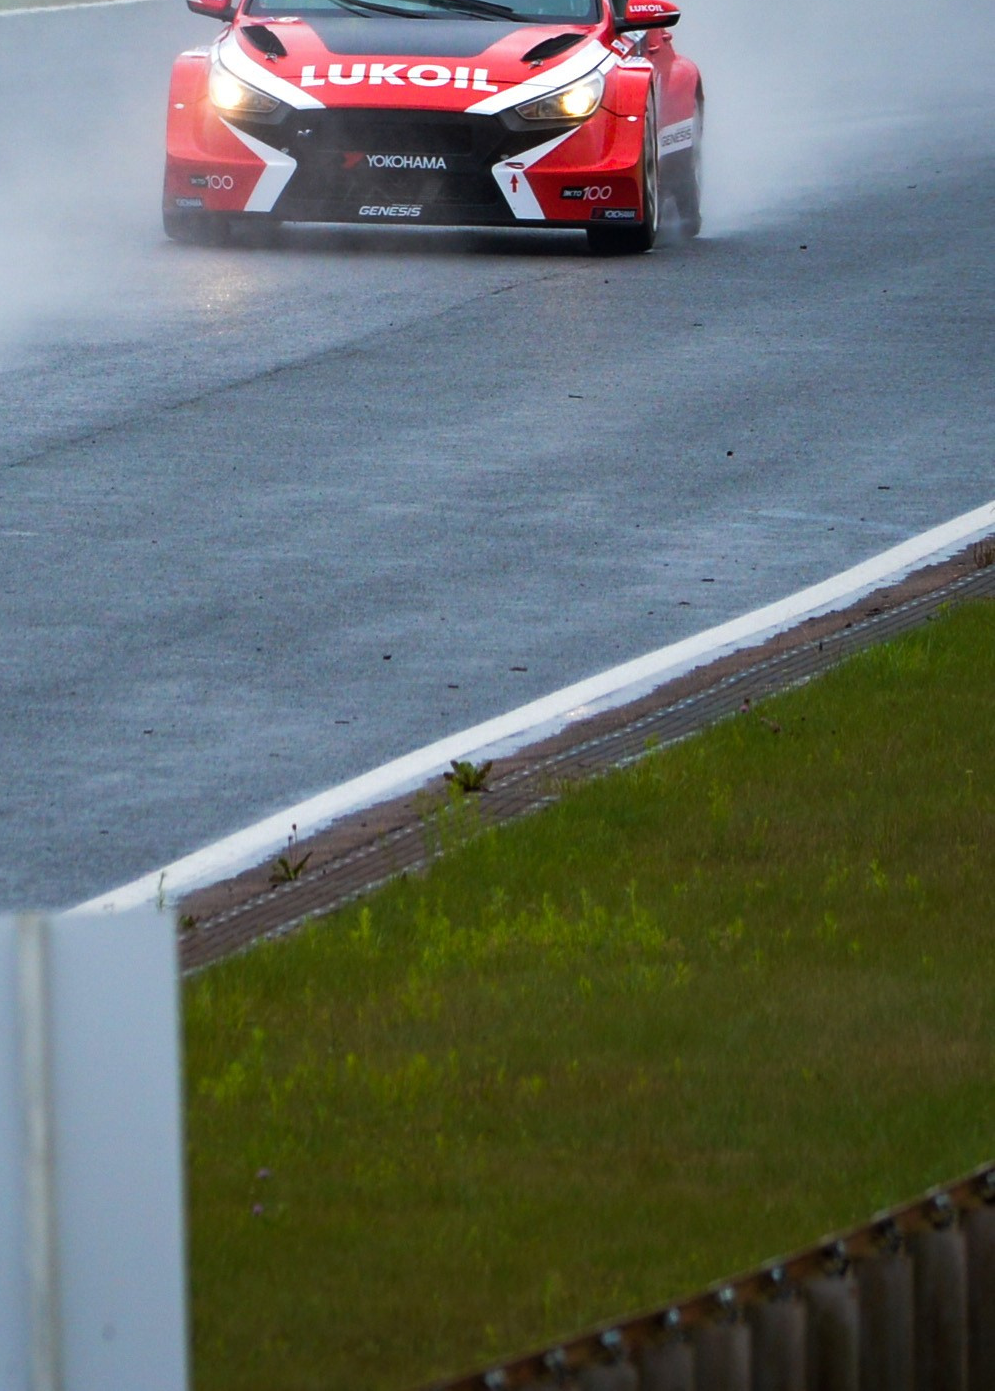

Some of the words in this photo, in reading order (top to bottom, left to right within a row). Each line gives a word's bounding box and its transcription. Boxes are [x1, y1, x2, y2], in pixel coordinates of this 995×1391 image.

[629, 5, 664, 13] LUKOIL
[301, 64, 498, 92] LUKOIL
[367, 155, 447, 169] YOKOHAMA
[359, 205, 421, 217] GENESIS
